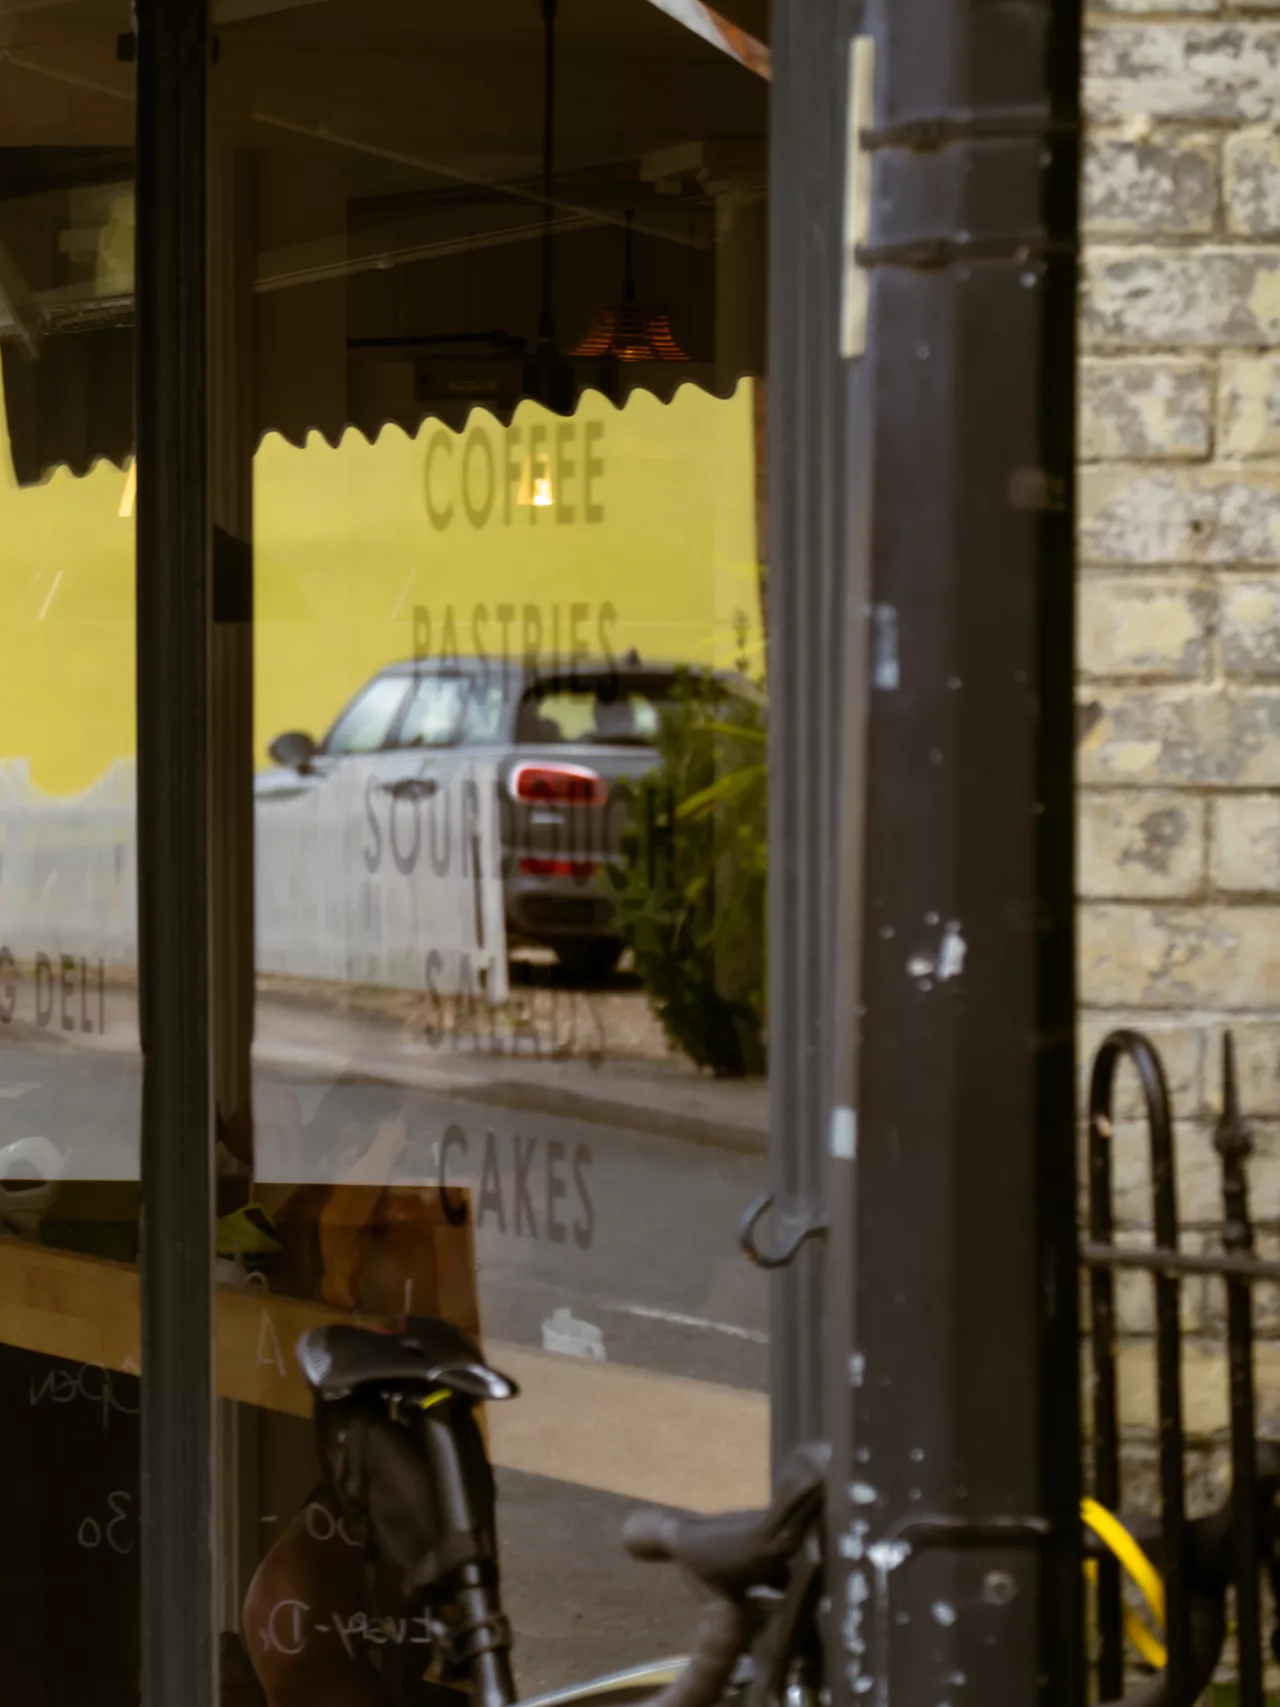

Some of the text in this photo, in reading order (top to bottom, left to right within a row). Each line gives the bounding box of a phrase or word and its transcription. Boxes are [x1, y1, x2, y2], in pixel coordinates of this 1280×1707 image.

[424, 420, 605, 532] COFFEE
[412, 600, 619, 704] PASTRIES
[35, 951, 106, 1035] DELI
[437, 1123, 596, 1251] CAKES
